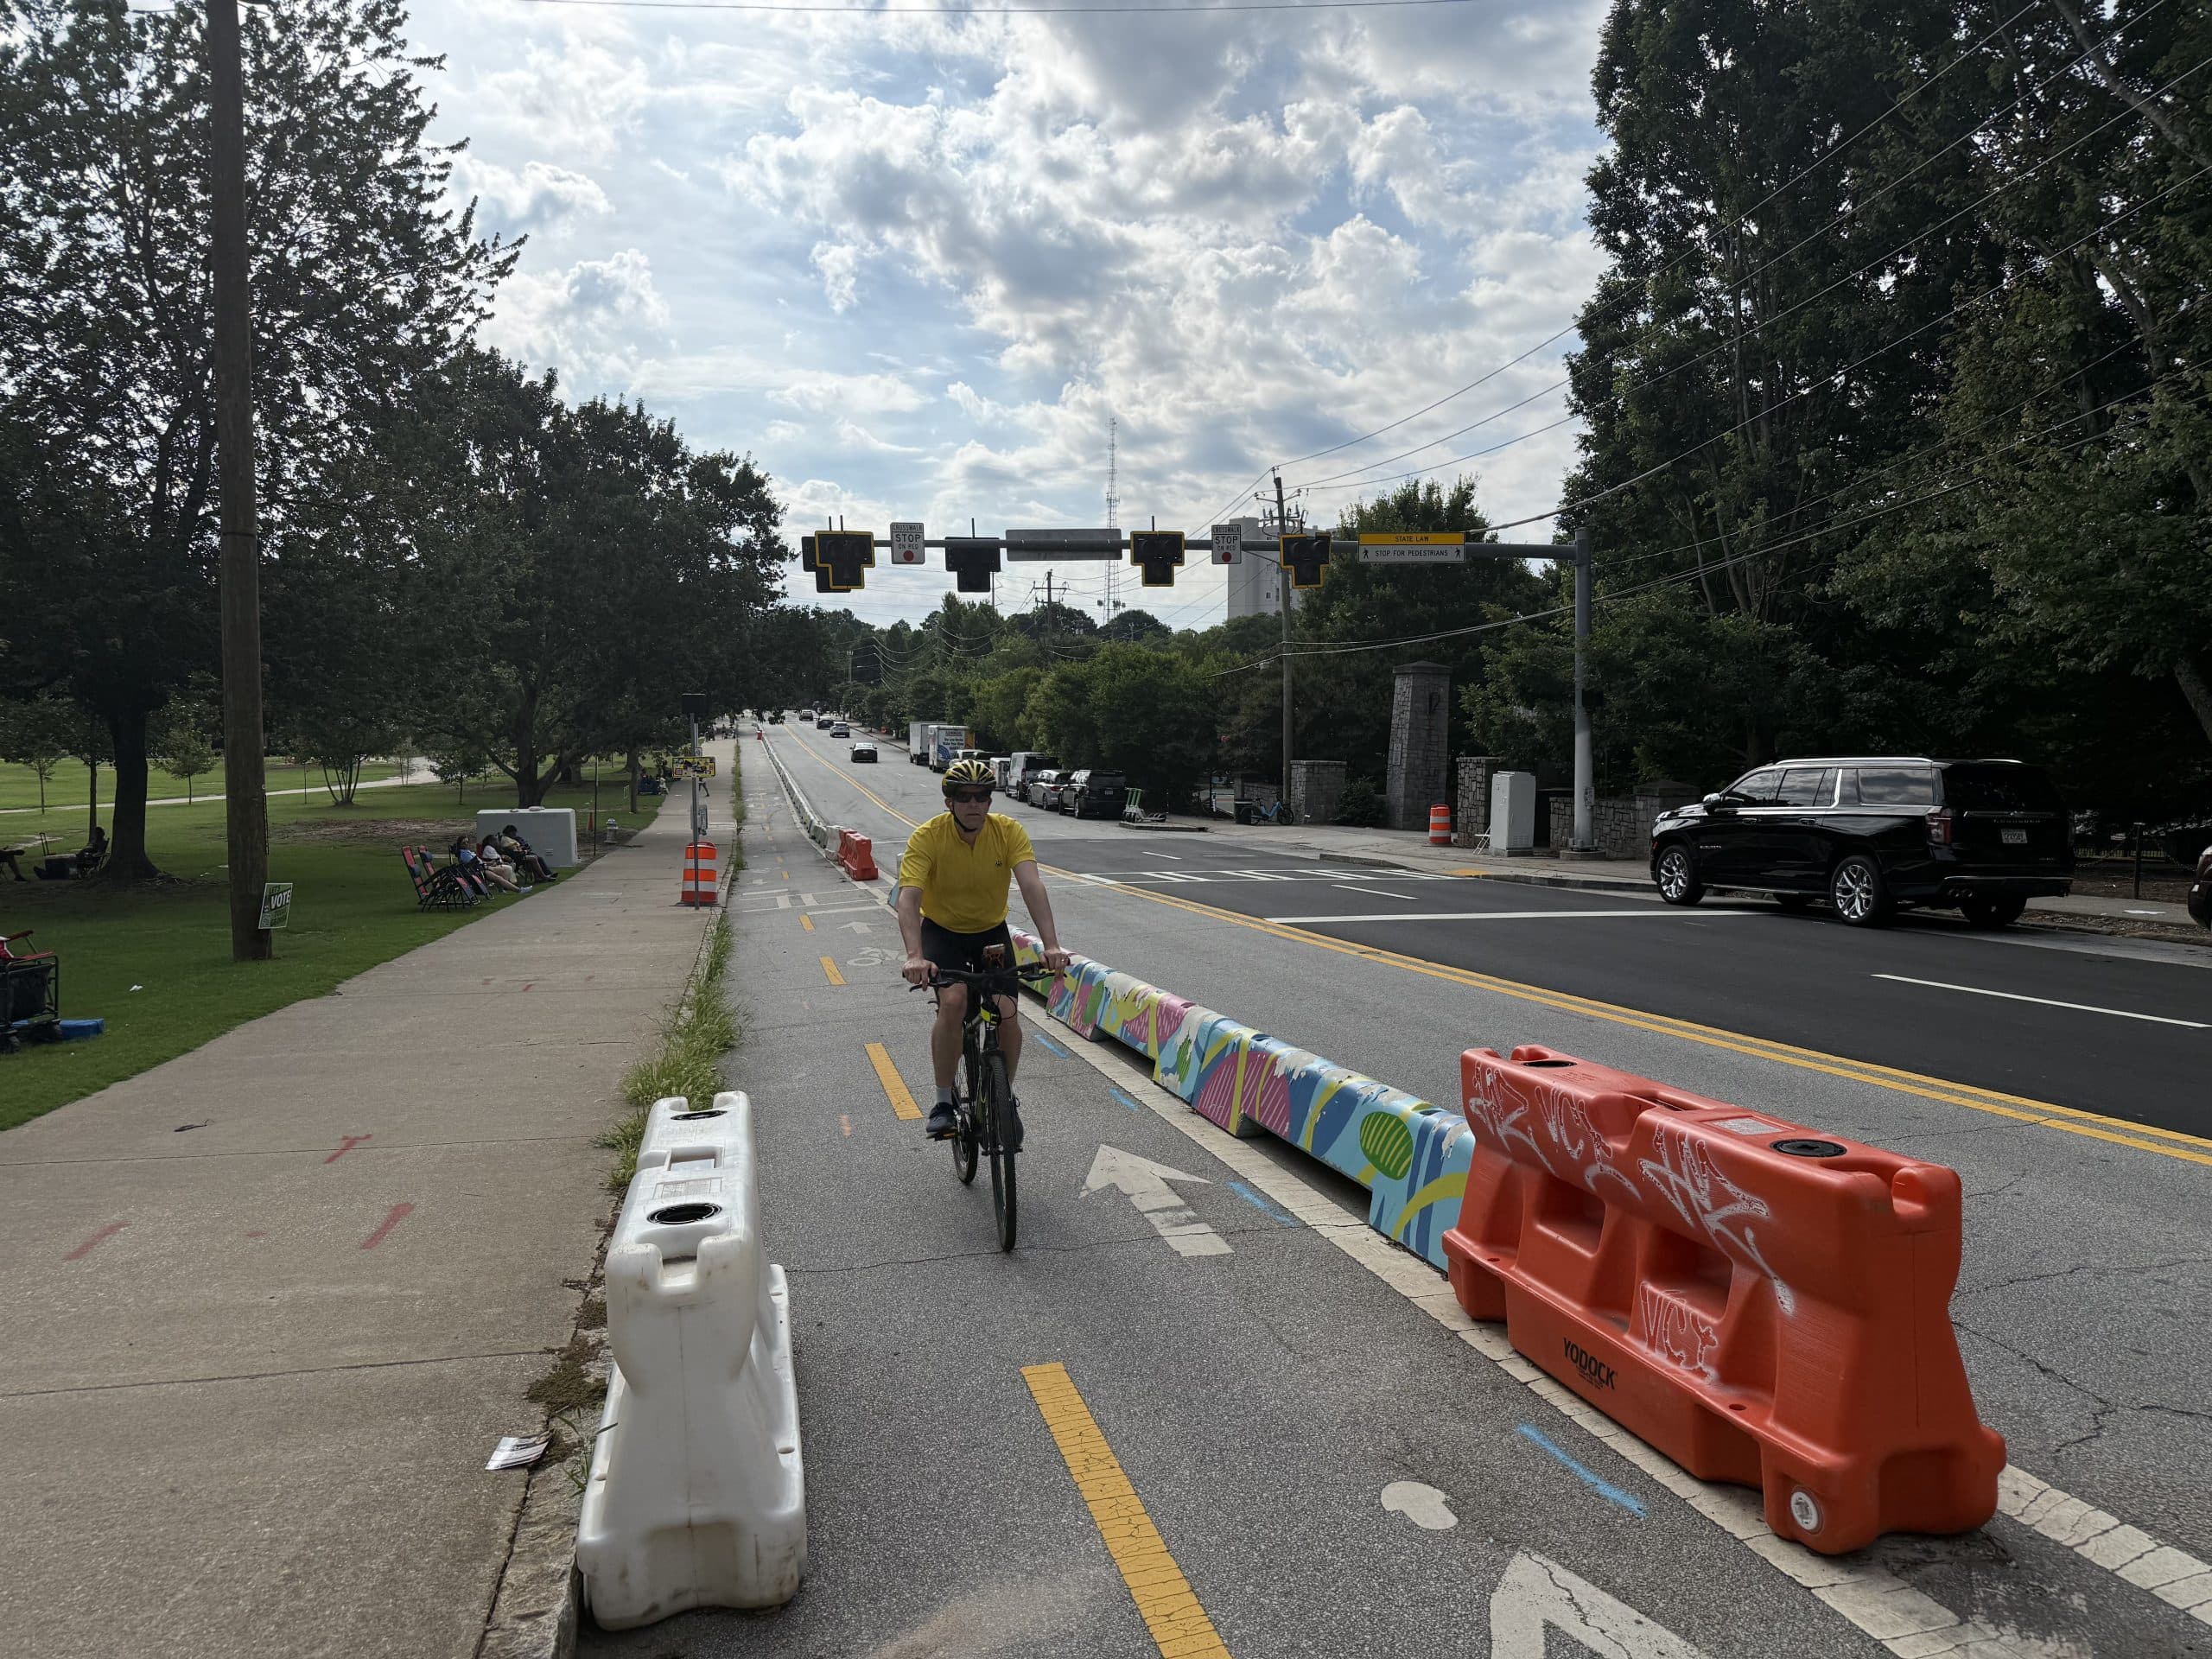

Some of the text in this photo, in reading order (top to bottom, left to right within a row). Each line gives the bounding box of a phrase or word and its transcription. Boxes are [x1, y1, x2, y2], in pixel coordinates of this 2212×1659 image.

[896, 533, 921, 543] STOP
[1215, 536, 1238, 544] STOP
[270, 889, 291, 910] VOTE
[1562, 1336, 1615, 1390] YODOCK
